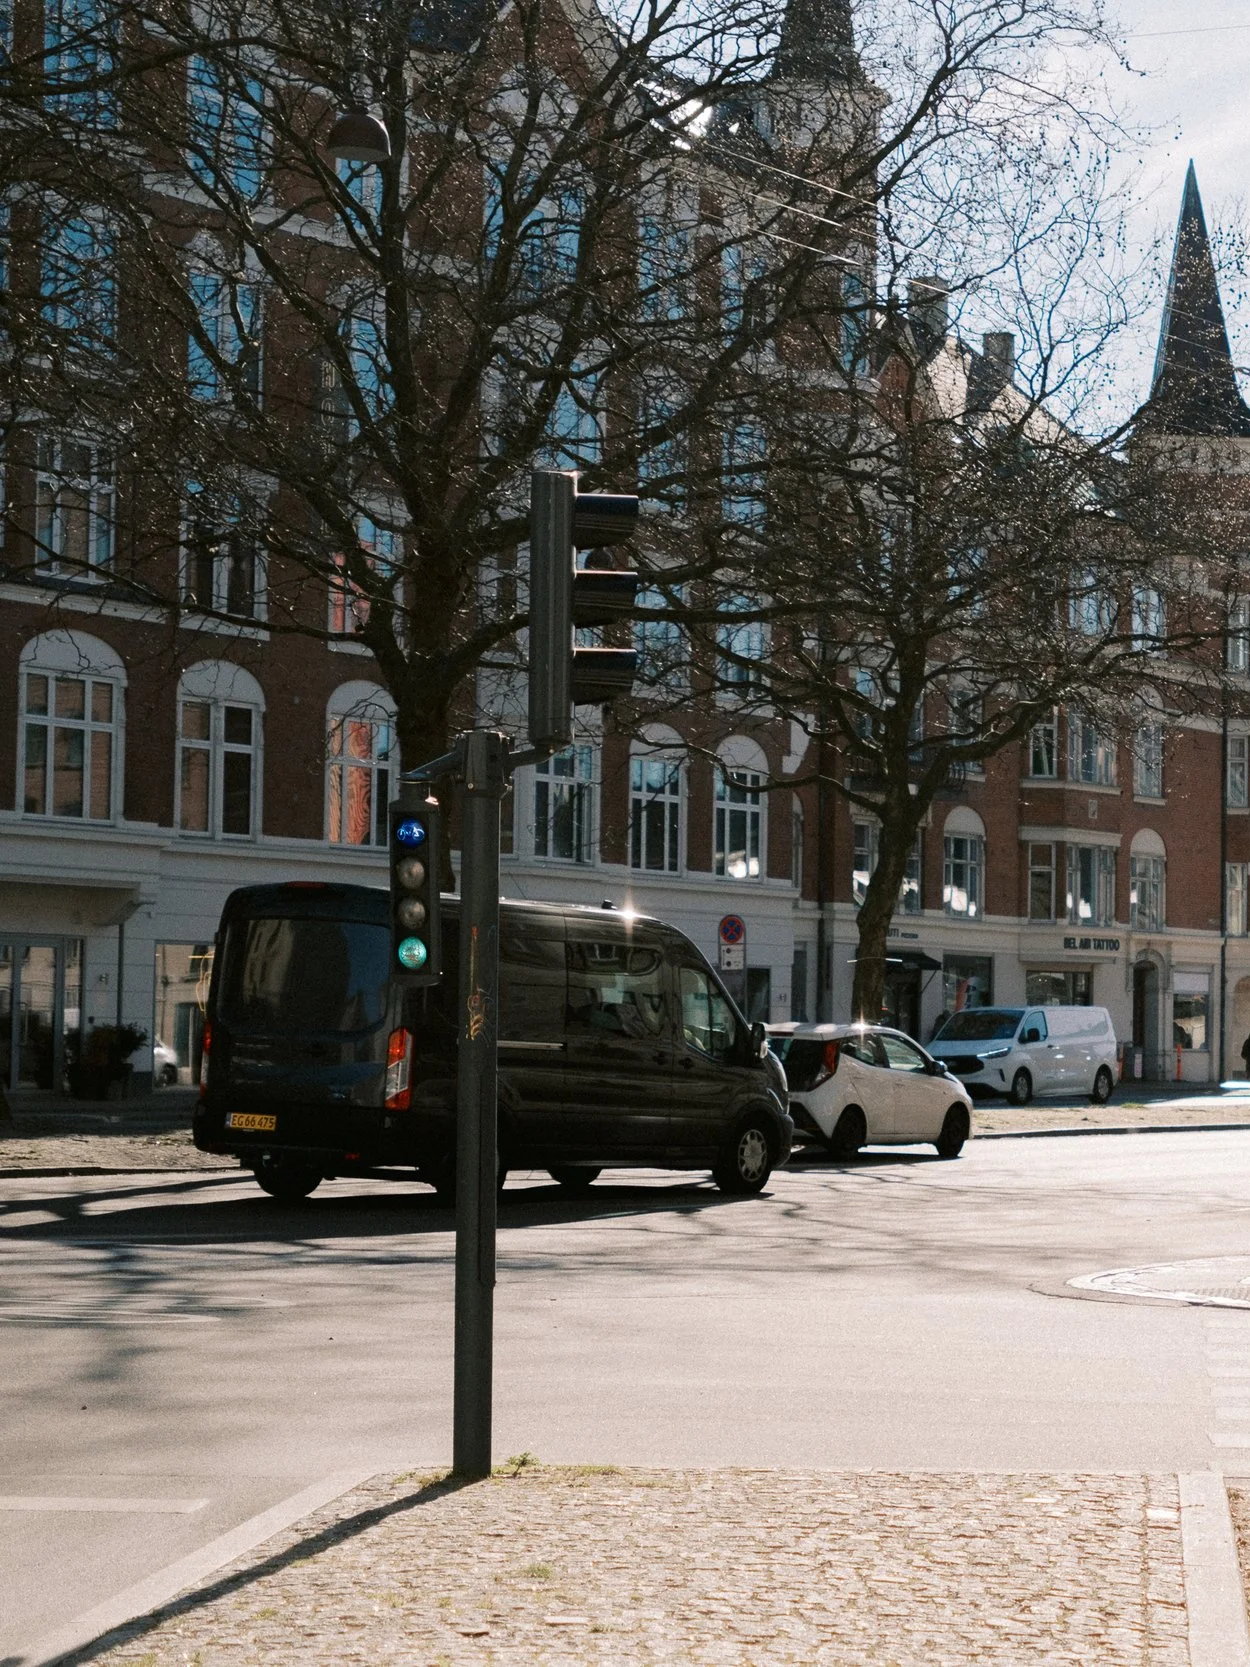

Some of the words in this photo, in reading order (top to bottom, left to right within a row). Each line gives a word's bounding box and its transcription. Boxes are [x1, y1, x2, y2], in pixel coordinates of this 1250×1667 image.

[1063, 937, 1078, 949] BEL
[1092, 938, 1120, 951] TATTOO
[231, 1114, 244, 1126] EG
[244, 1115, 256, 1128] 66
[257, 1116, 274, 1129] 475
